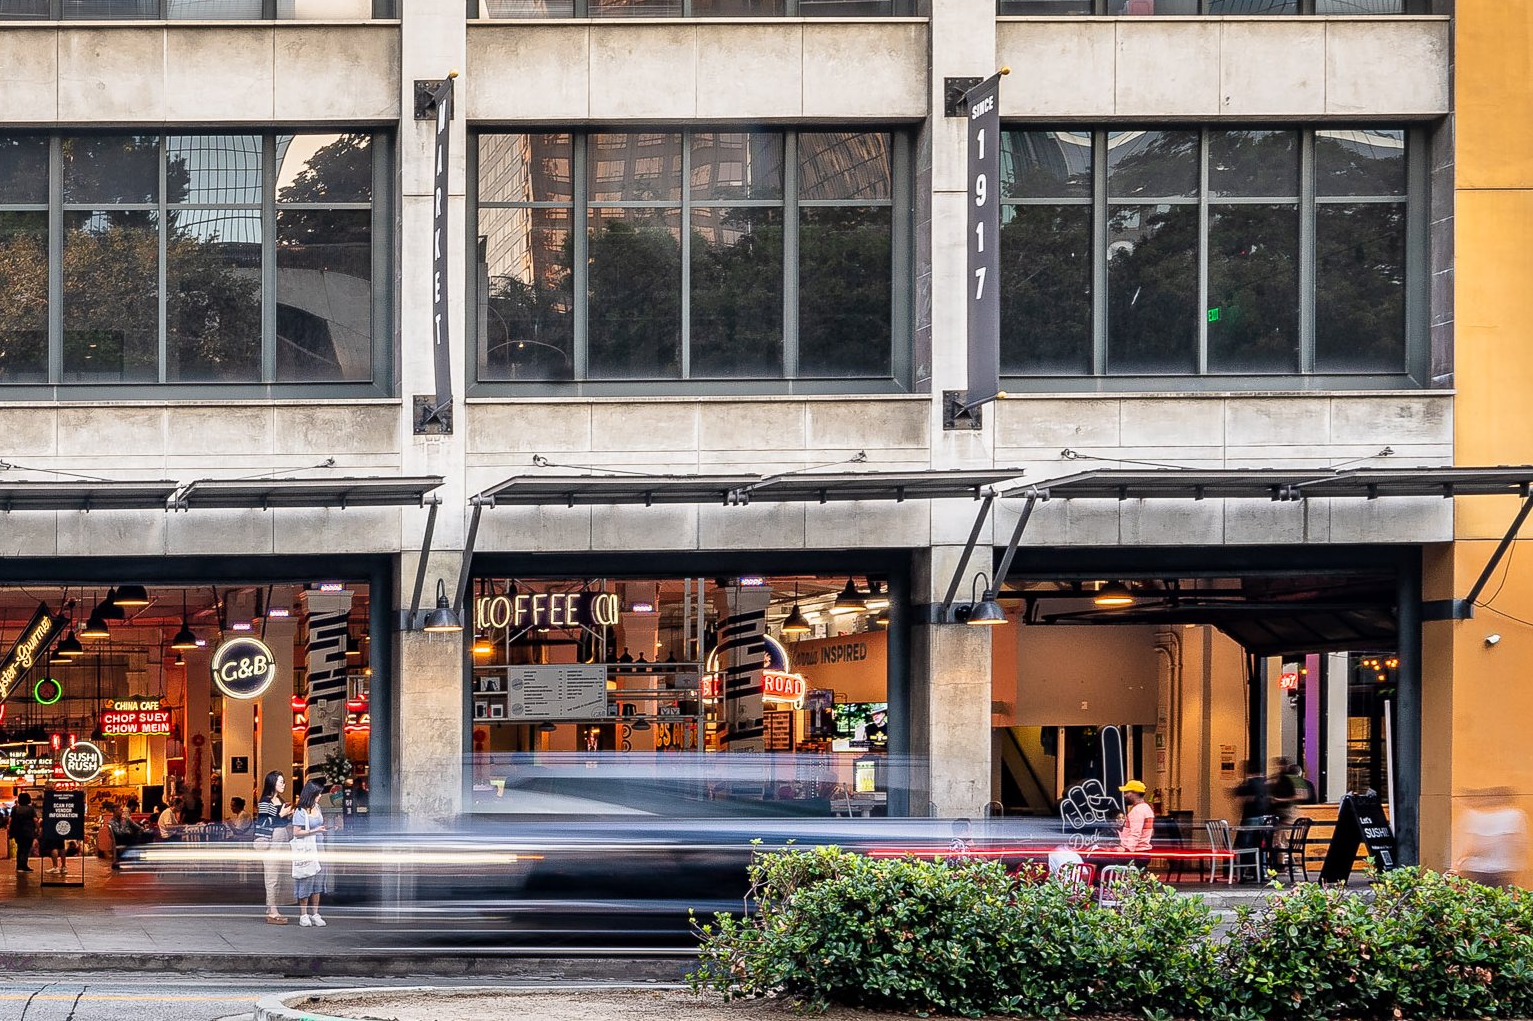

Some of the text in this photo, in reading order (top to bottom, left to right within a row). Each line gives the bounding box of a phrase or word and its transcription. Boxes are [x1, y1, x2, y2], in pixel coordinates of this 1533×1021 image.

[972, 95, 994, 119] SINCE
[435, 98, 448, 345] MARKET
[975, 129, 986, 299] 1917
[481, 593, 580, 628] COFFEE
[821, 642, 867, 664] INSPIRED
[221, 655, 268, 681] G&B
[764, 676, 803, 695] ROAD
[114, 701, 159, 711] CHINA CAFE
[104, 713, 168, 723] CHOP SUEY
[105, 723, 169, 733] CHOW MEIN
[68, 753, 98, 763] SUSHI
[68, 762, 98, 771] RUSH
